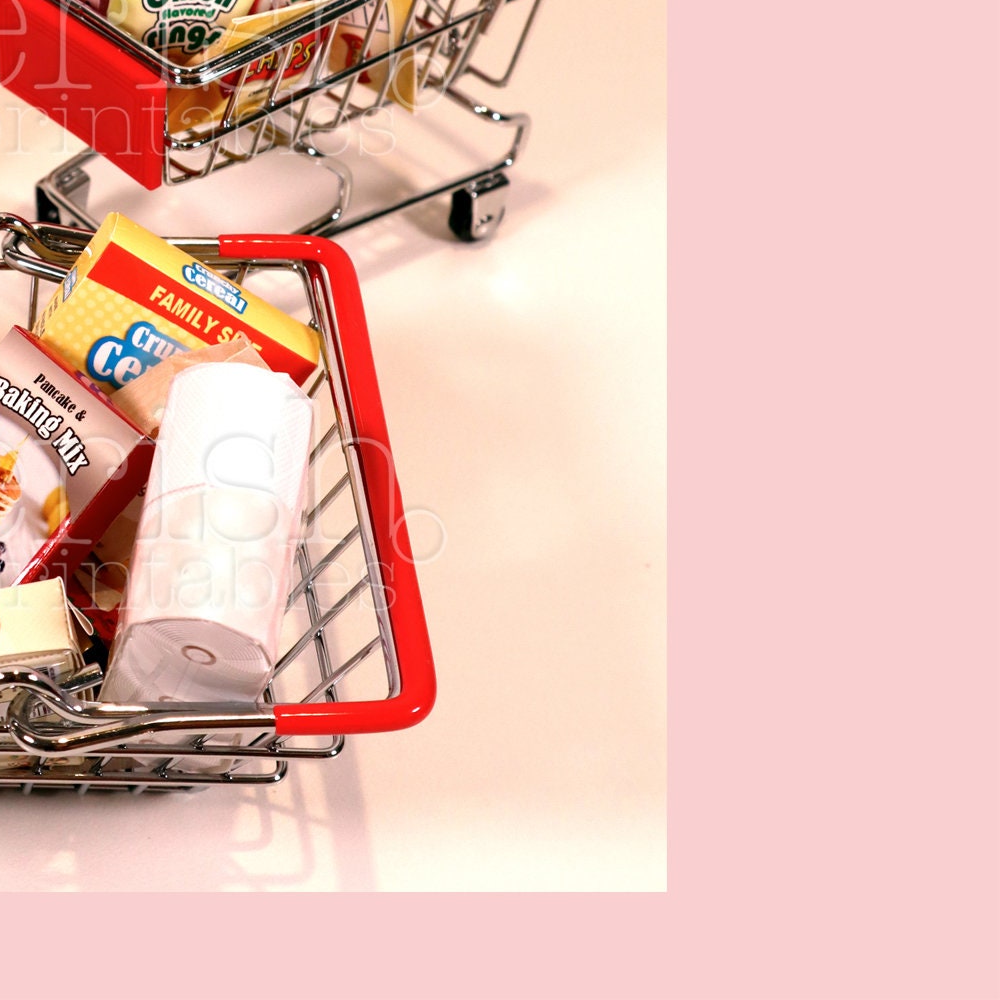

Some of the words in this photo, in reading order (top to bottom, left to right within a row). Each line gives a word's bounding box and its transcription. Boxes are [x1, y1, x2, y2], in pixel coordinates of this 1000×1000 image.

[149, 285, 221, 335] FAMILY
[183, 266, 247, 314] Cereal
[34, 372, 77, 414] Pancake
[75, 409, 87, 422] &
[51, 427, 91, 476] Mix
